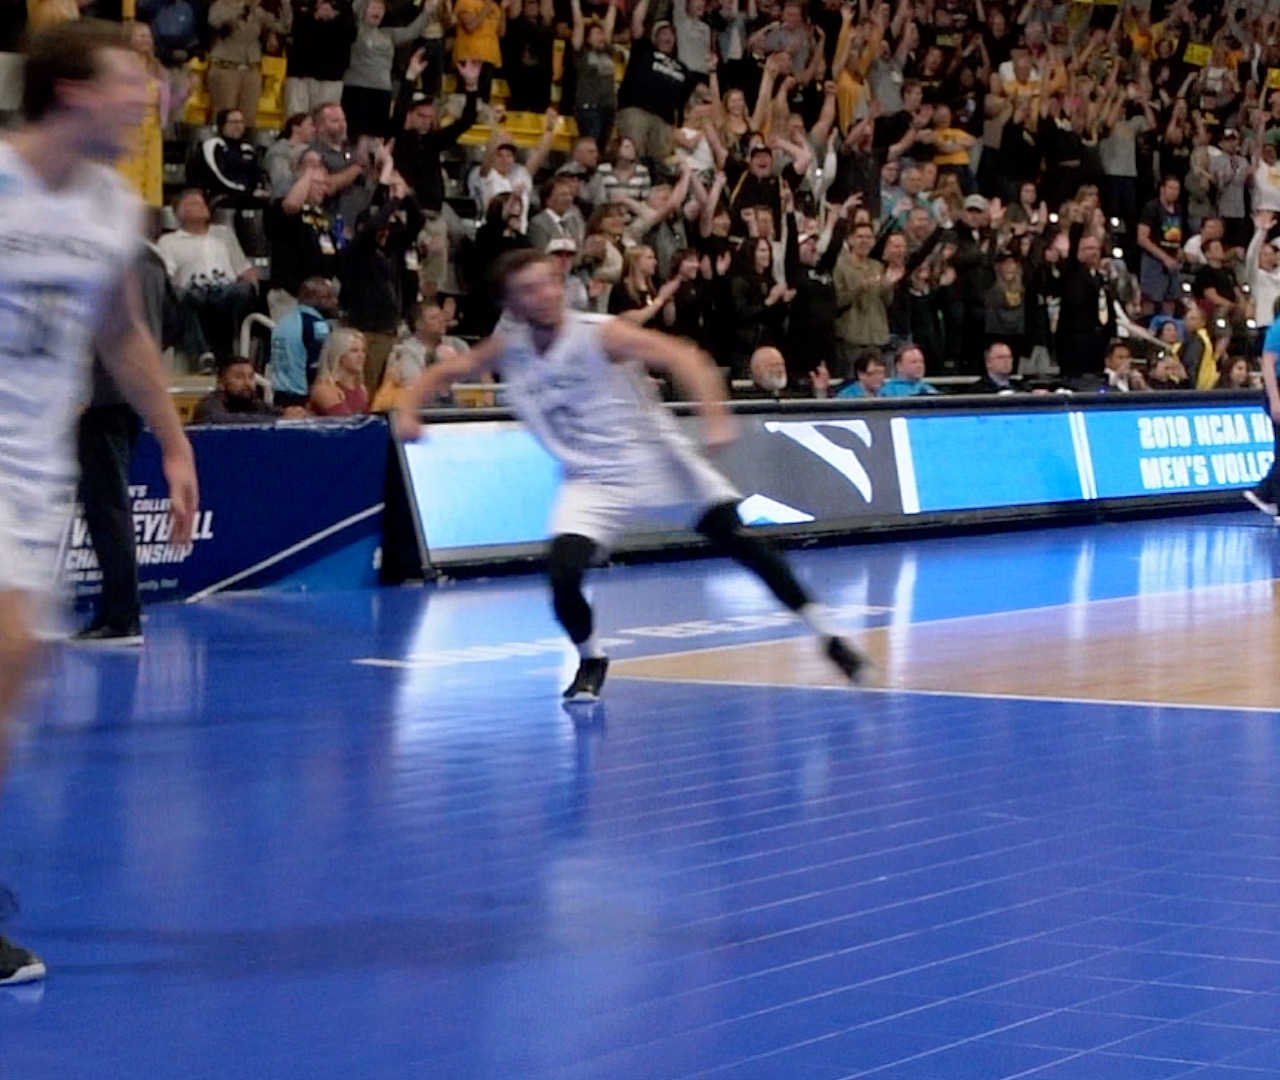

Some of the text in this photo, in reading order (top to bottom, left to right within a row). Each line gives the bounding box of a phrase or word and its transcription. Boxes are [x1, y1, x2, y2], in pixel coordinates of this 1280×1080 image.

[1138, 416, 1191, 449] 2019
[1194, 413, 1248, 446] NCAA
[1140, 454, 1209, 489] MEN'S
